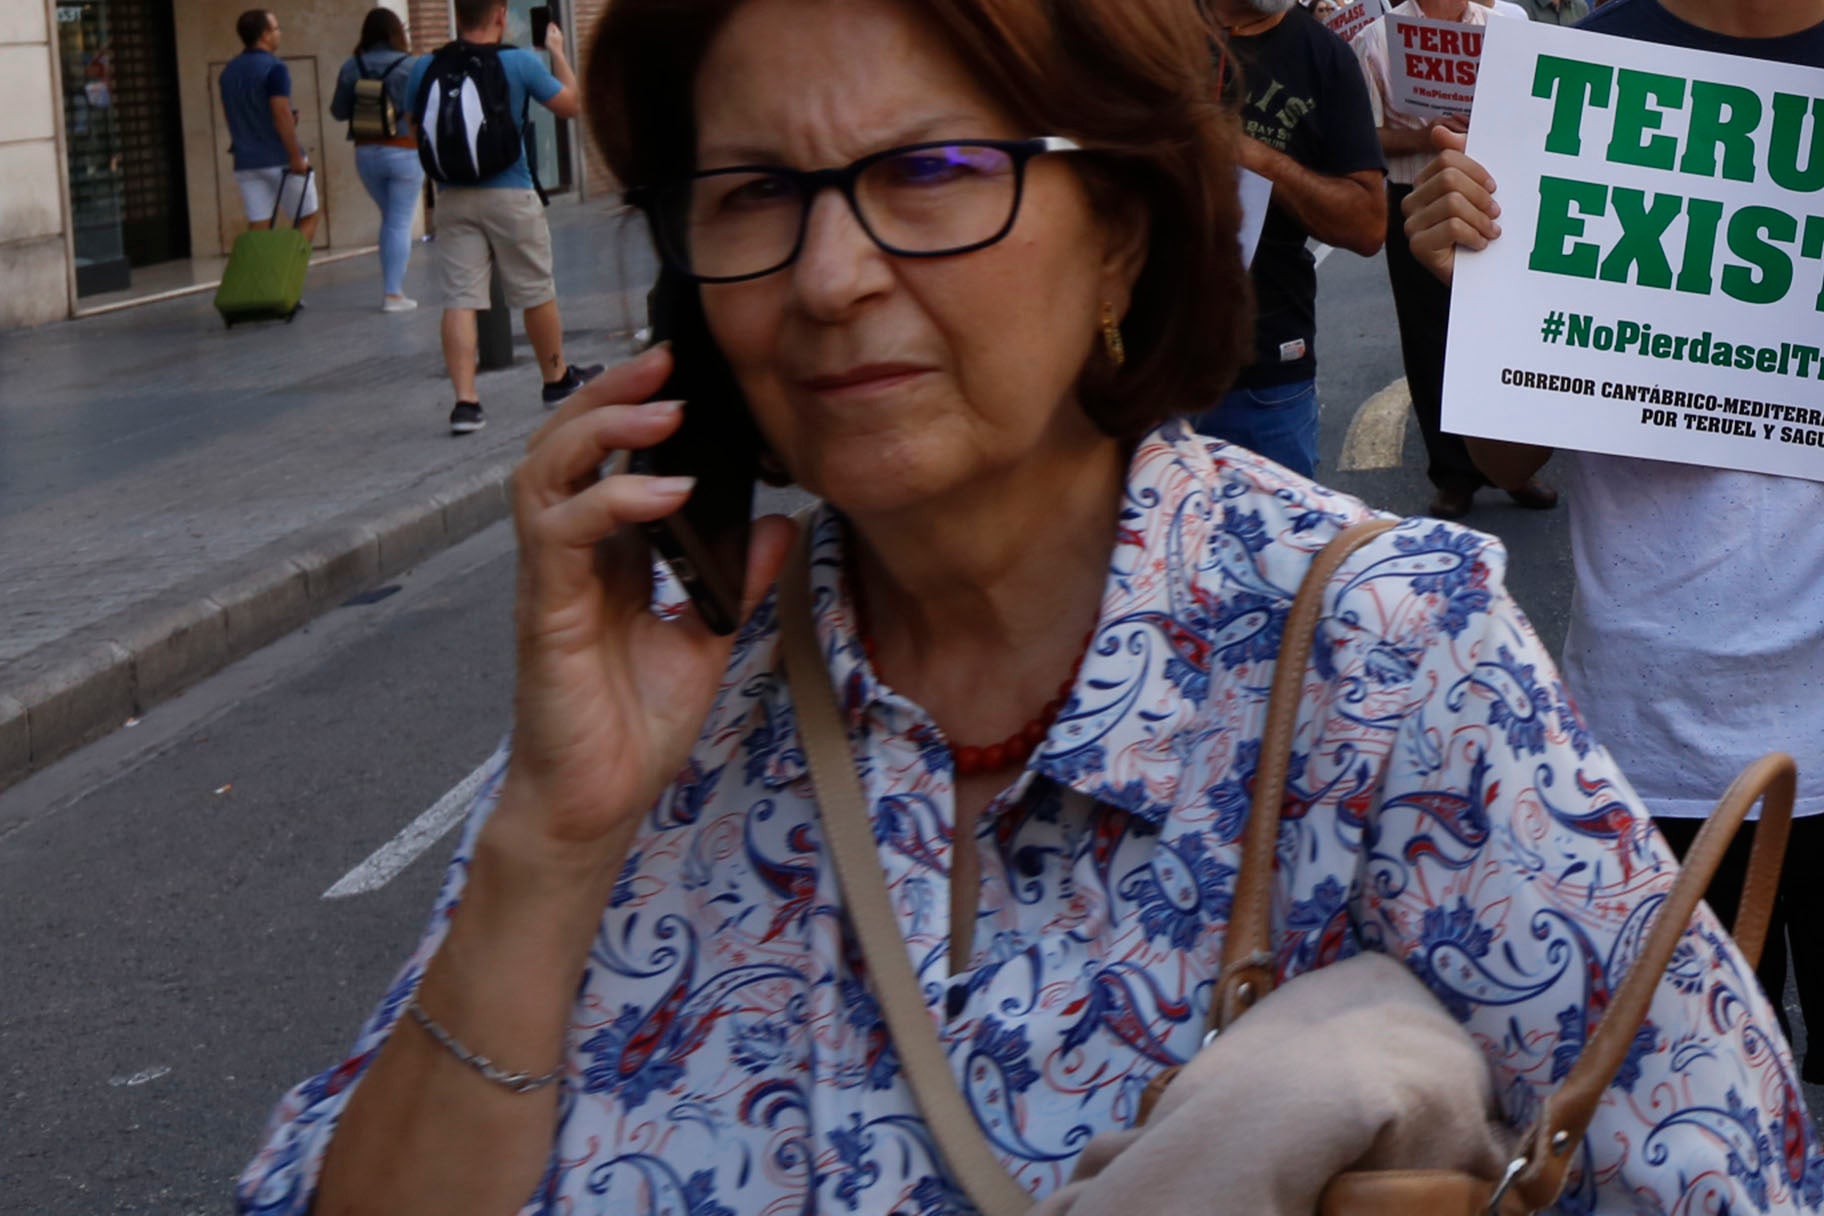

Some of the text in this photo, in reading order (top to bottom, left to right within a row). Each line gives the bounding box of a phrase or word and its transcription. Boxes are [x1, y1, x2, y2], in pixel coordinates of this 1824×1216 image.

[1397, 22, 1483, 58] TERU
[1405, 53, 1477, 87] EXIS
[1501, 369, 1595, 397] CORREDOR
[1641, 409, 1677, 427] POR
[1684, 414, 1756, 437] TERUEL
[1763, 424, 1775, 439] Y
